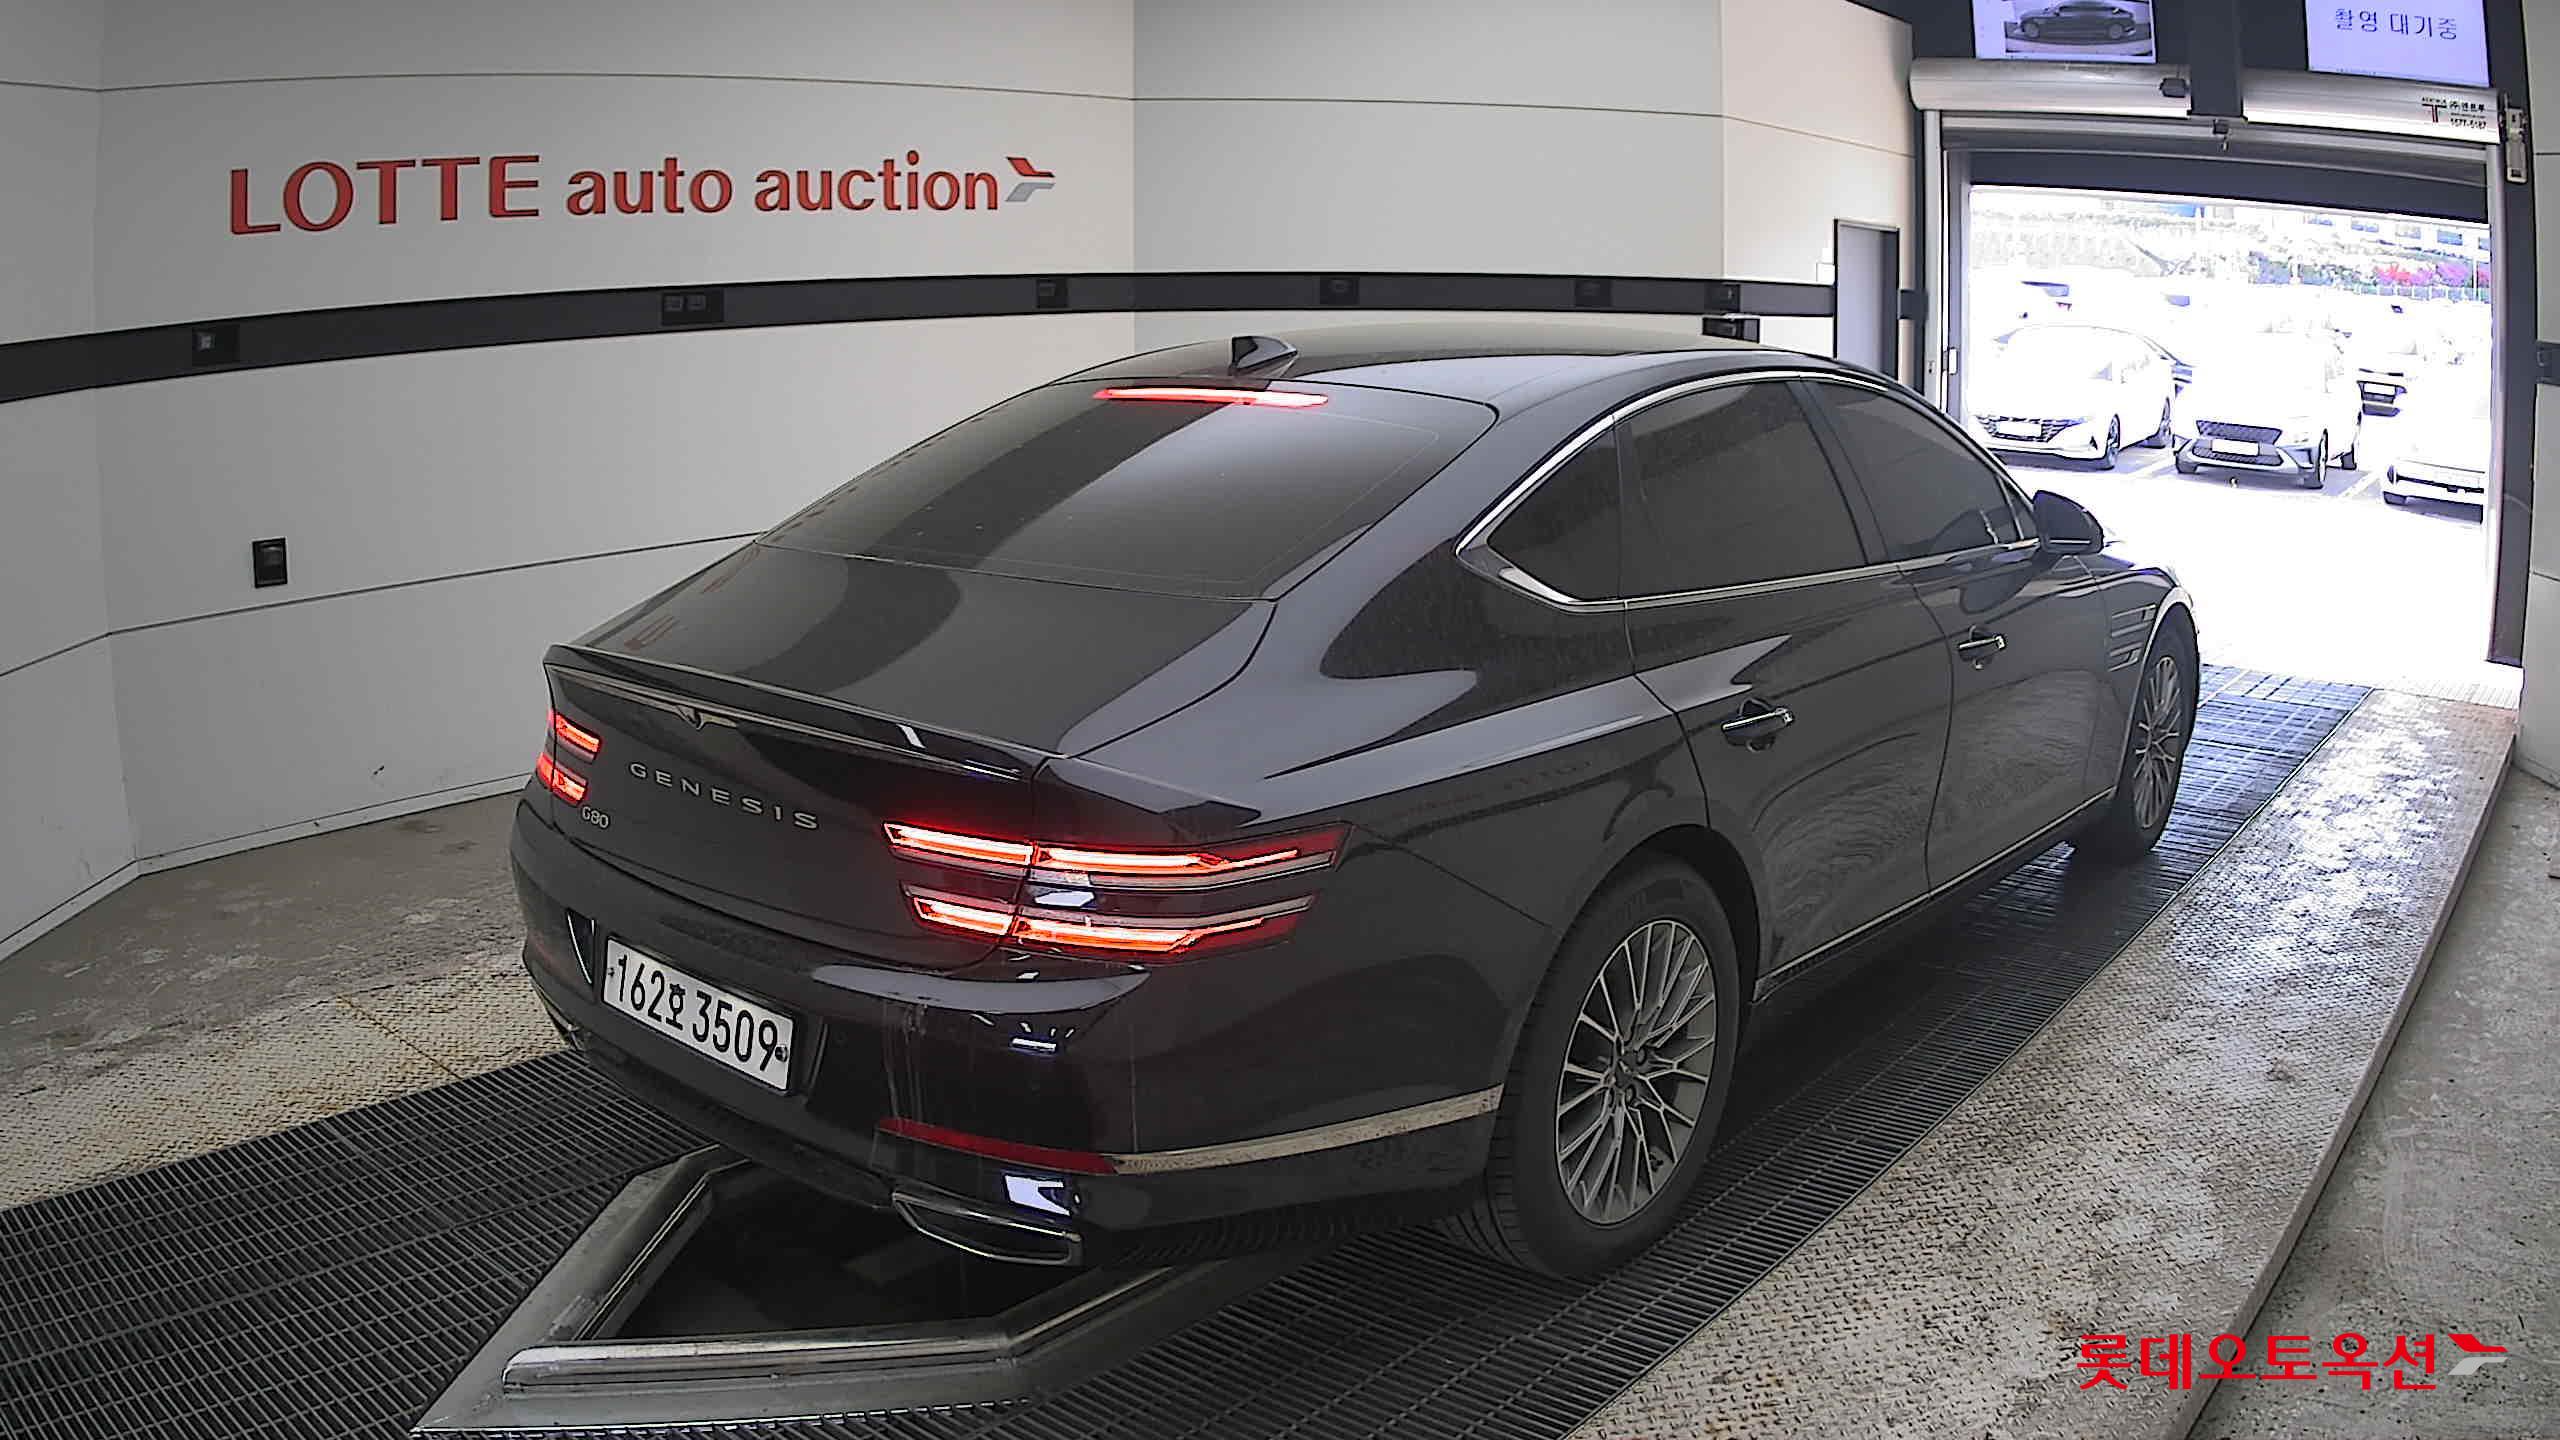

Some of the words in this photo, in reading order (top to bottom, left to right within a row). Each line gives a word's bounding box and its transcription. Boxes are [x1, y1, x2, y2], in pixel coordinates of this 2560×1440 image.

[2335, 8, 2378, 33] 촬영
[2390, 13, 2457, 40] 대기중
[231, 155, 541, 235] LOTTE
[566, 156, 734, 216] auto
[754, 150, 999, 212] auction
[581, 805, 610, 830] G80
[629, 762, 819, 830] GENESIS
